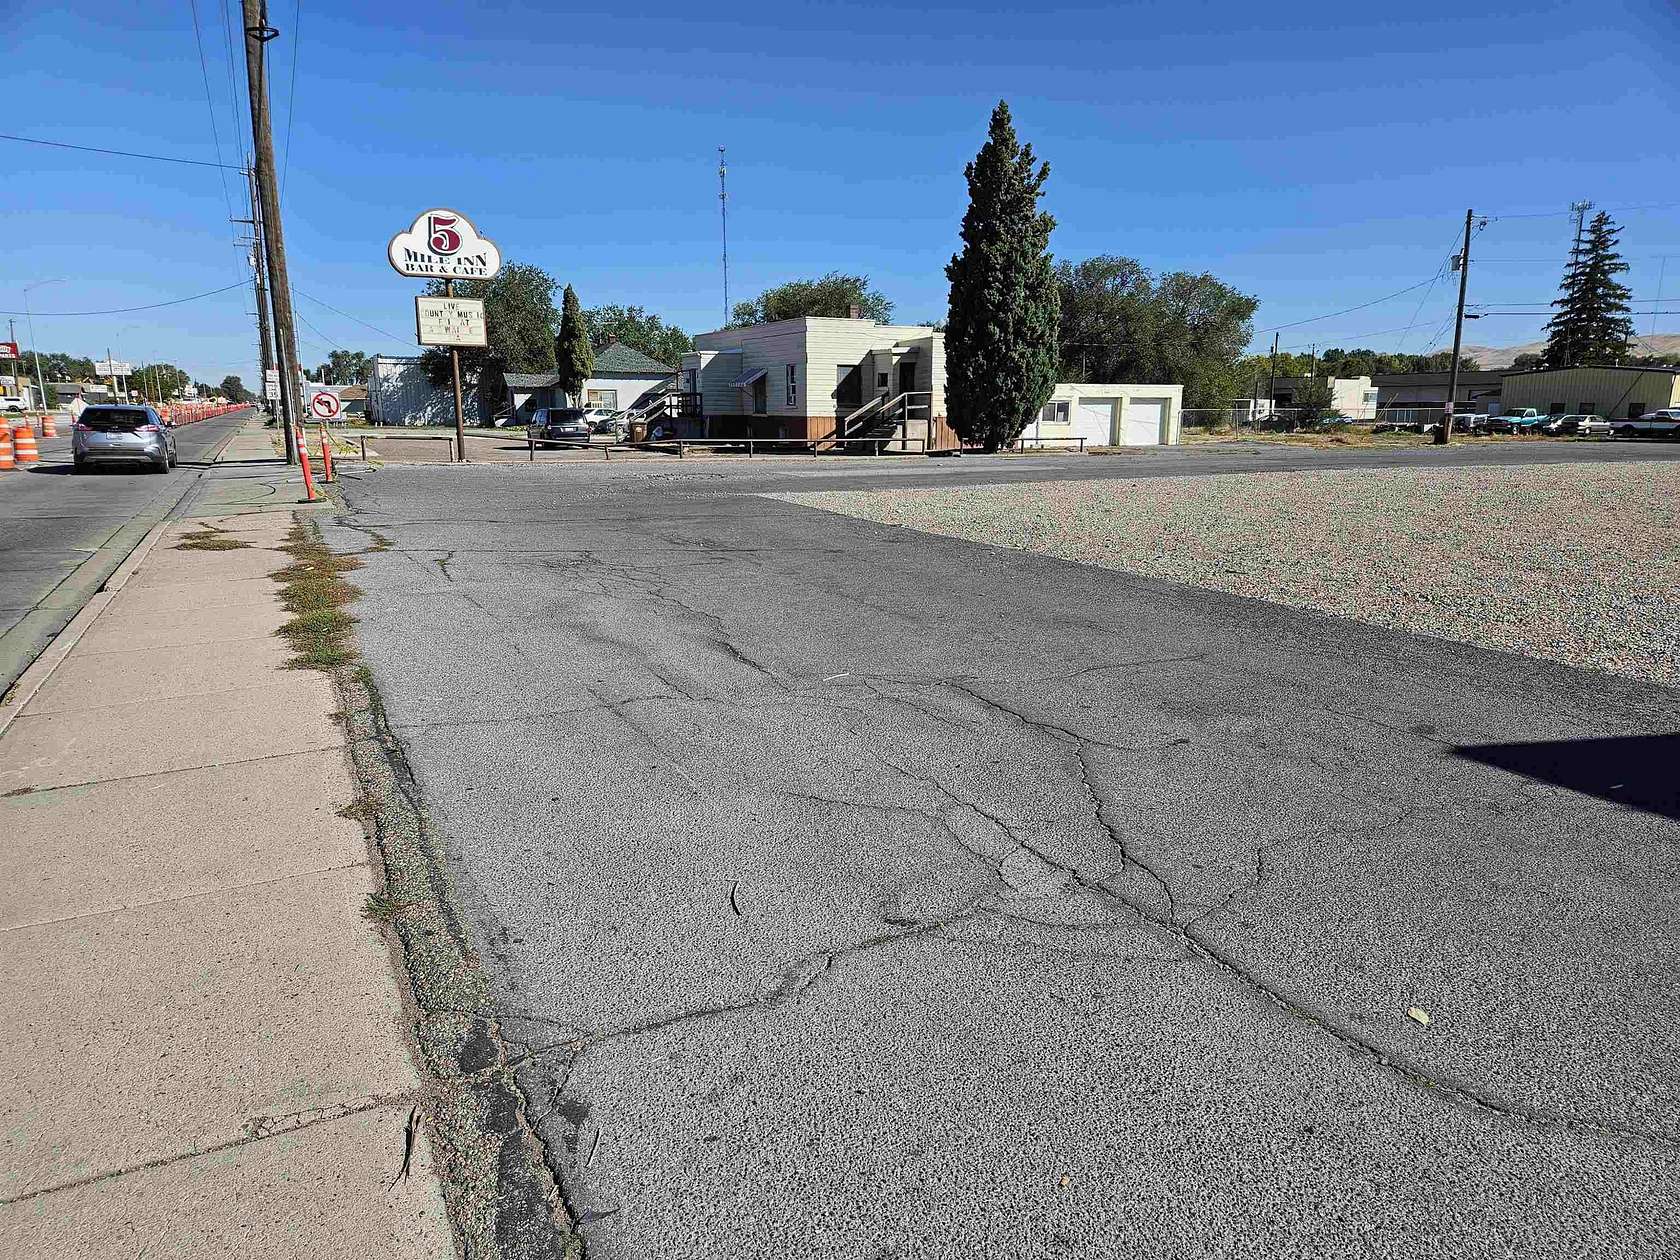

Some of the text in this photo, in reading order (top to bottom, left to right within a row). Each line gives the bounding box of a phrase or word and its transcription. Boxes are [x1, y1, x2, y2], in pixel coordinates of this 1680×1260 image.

[427, 214, 463, 256] 5
[404, 247, 487, 267] MILE INN
[405, 263, 434, 272] BAR
[453, 266, 488, 276] CAFE
[443, 302, 460, 311] LIVE
